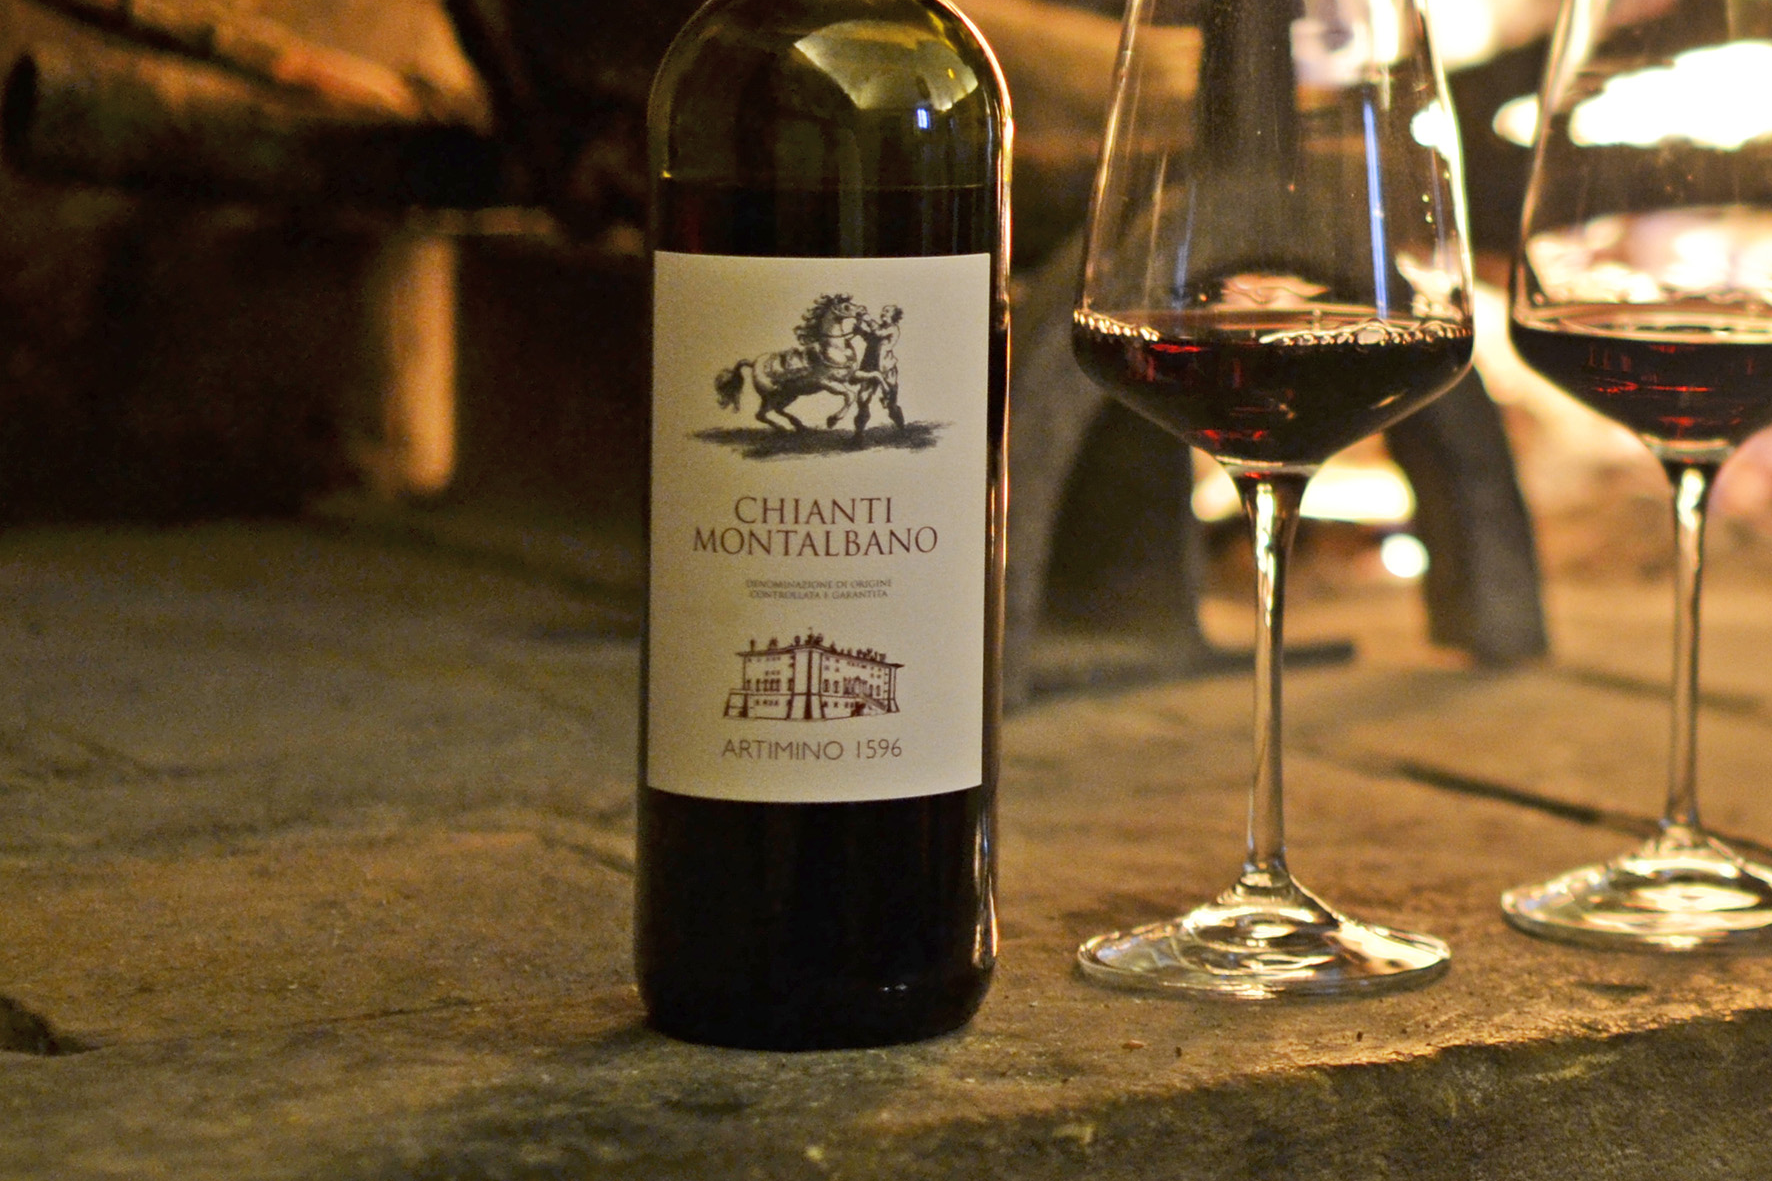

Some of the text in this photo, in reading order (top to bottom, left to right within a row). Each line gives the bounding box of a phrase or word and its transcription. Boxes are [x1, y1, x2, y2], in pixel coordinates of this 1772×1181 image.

[735, 496, 893, 524] CHIANTI
[692, 526, 939, 557] MONTALBANO
[745, 579, 892, 589] DENOMINAZIONE DI ORIGINE
[749, 590, 821, 599] CONTROLLATA
[832, 590, 888, 599] GARANTITA
[721, 738, 903, 761] ARTIMINO 1596
